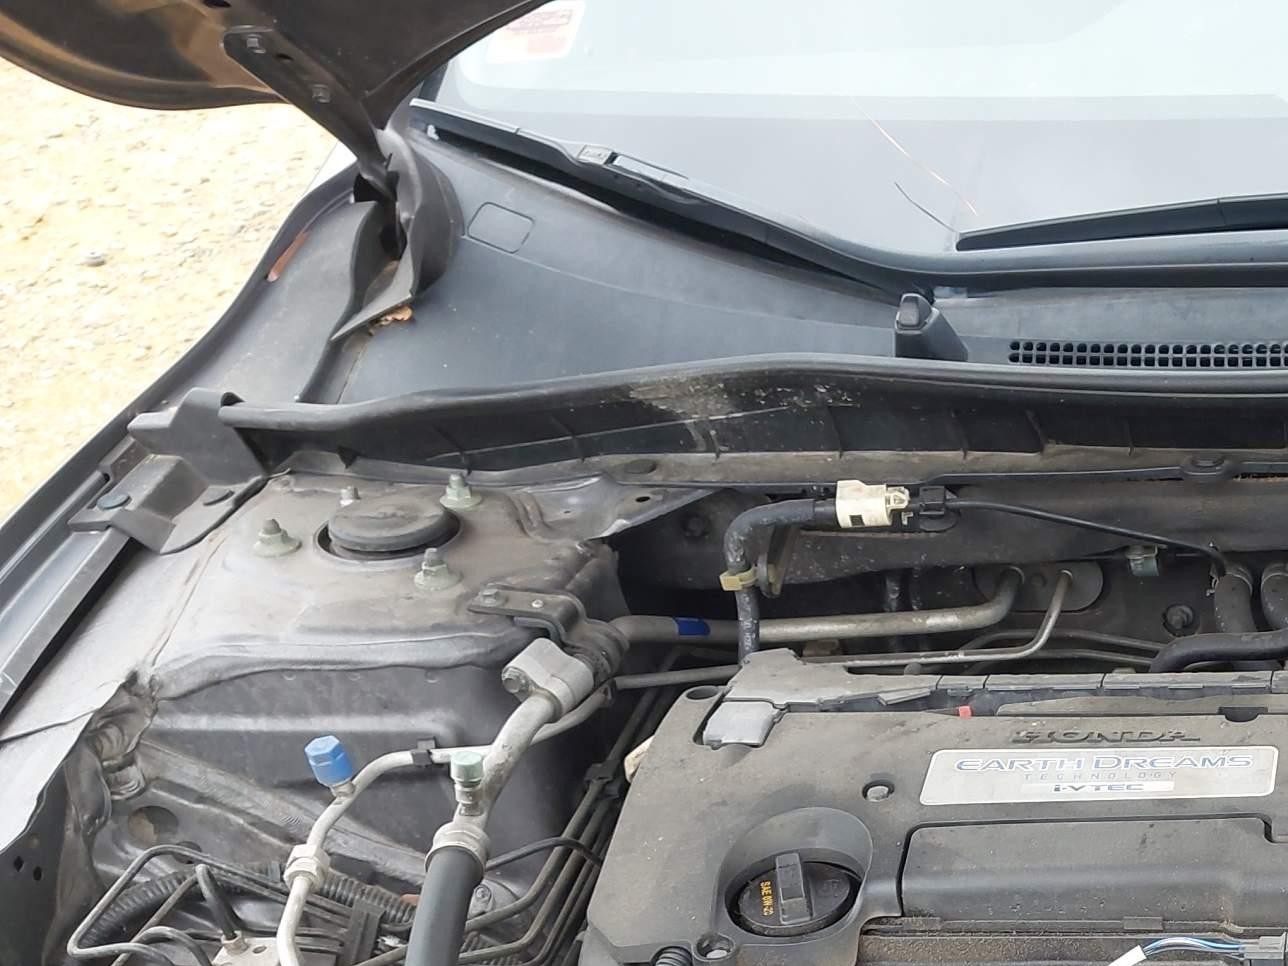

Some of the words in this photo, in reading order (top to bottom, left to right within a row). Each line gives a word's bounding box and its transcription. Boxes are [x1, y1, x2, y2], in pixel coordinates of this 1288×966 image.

[1012, 731, 1201, 744] HONDA
[955, 758, 1086, 771] EARTH
[1092, 754, 1256, 770] DREAMS
[1024, 771, 1177, 781] TECHNOLOGY
[1052, 783, 1145, 793] i-VTEC
